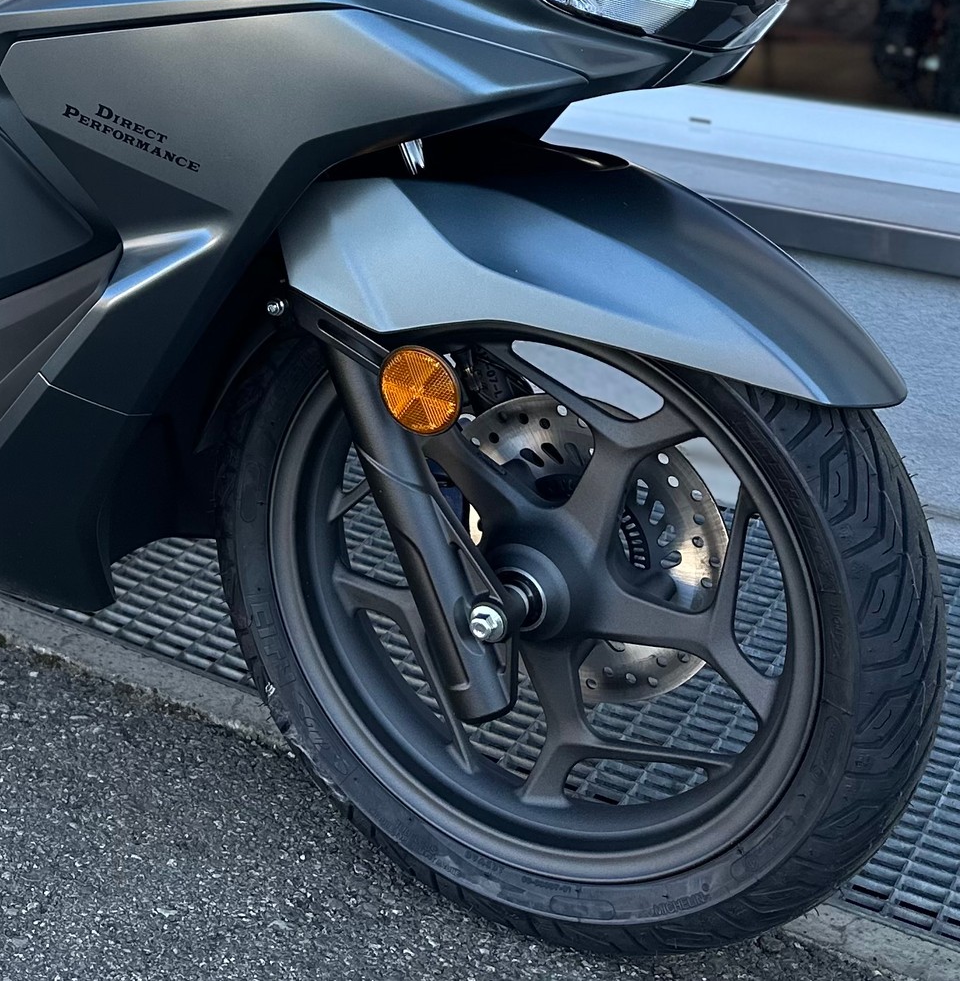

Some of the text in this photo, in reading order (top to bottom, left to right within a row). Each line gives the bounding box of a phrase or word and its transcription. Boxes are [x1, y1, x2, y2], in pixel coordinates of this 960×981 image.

[62, 104, 201, 173] PERFORMANCE
[95, 104, 168, 144] DIRECT
[653, 891, 705, 917] MICHELIN
